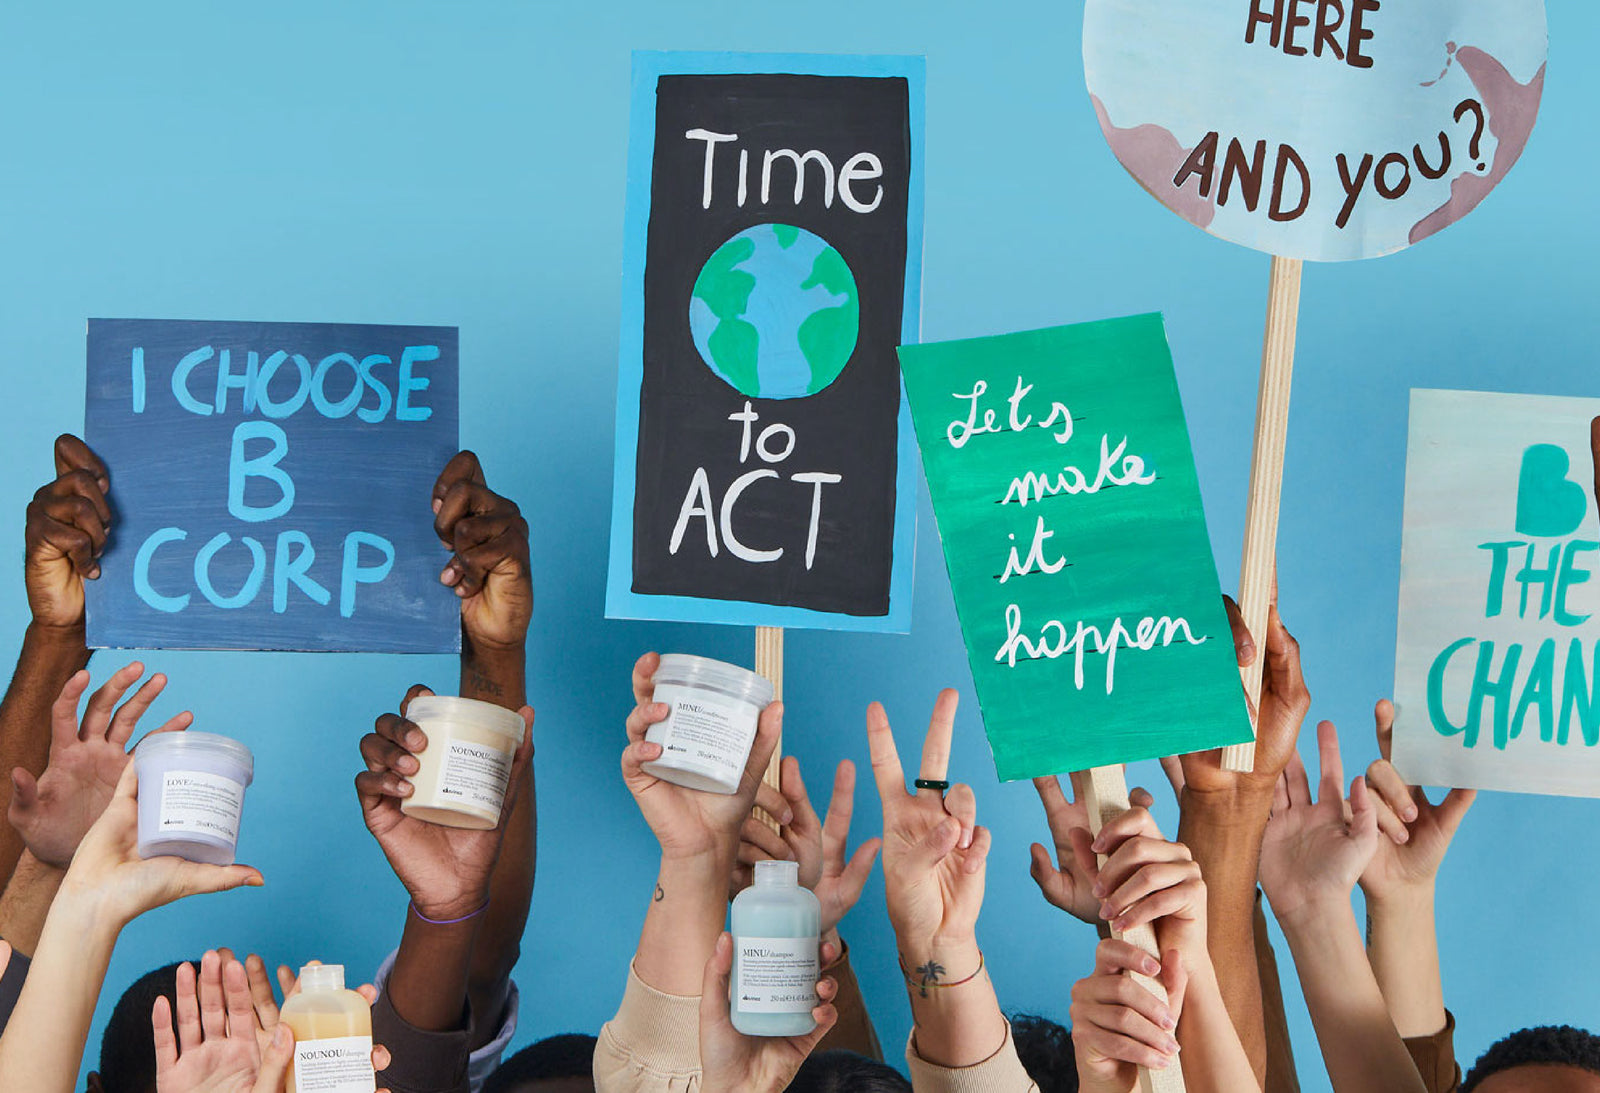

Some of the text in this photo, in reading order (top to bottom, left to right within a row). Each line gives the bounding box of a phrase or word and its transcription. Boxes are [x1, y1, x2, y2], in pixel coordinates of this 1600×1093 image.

[1245, 0, 1380, 68] HERE
[685, 128, 883, 213] Time
[1174, 98, 1485, 229] AND YOU?
[132, 345, 439, 423] I CHOOSE
[947, 375, 1074, 449] Lets
[228, 420, 296, 523] B
[728, 401, 796, 463] to
[1001, 433, 1157, 507] make
[669, 468, 842, 570] ACT
[1514, 443, 1588, 538] B
[133, 527, 396, 618] CORP
[999, 516, 1067, 584] it
[1477, 540, 1600, 627] THE
